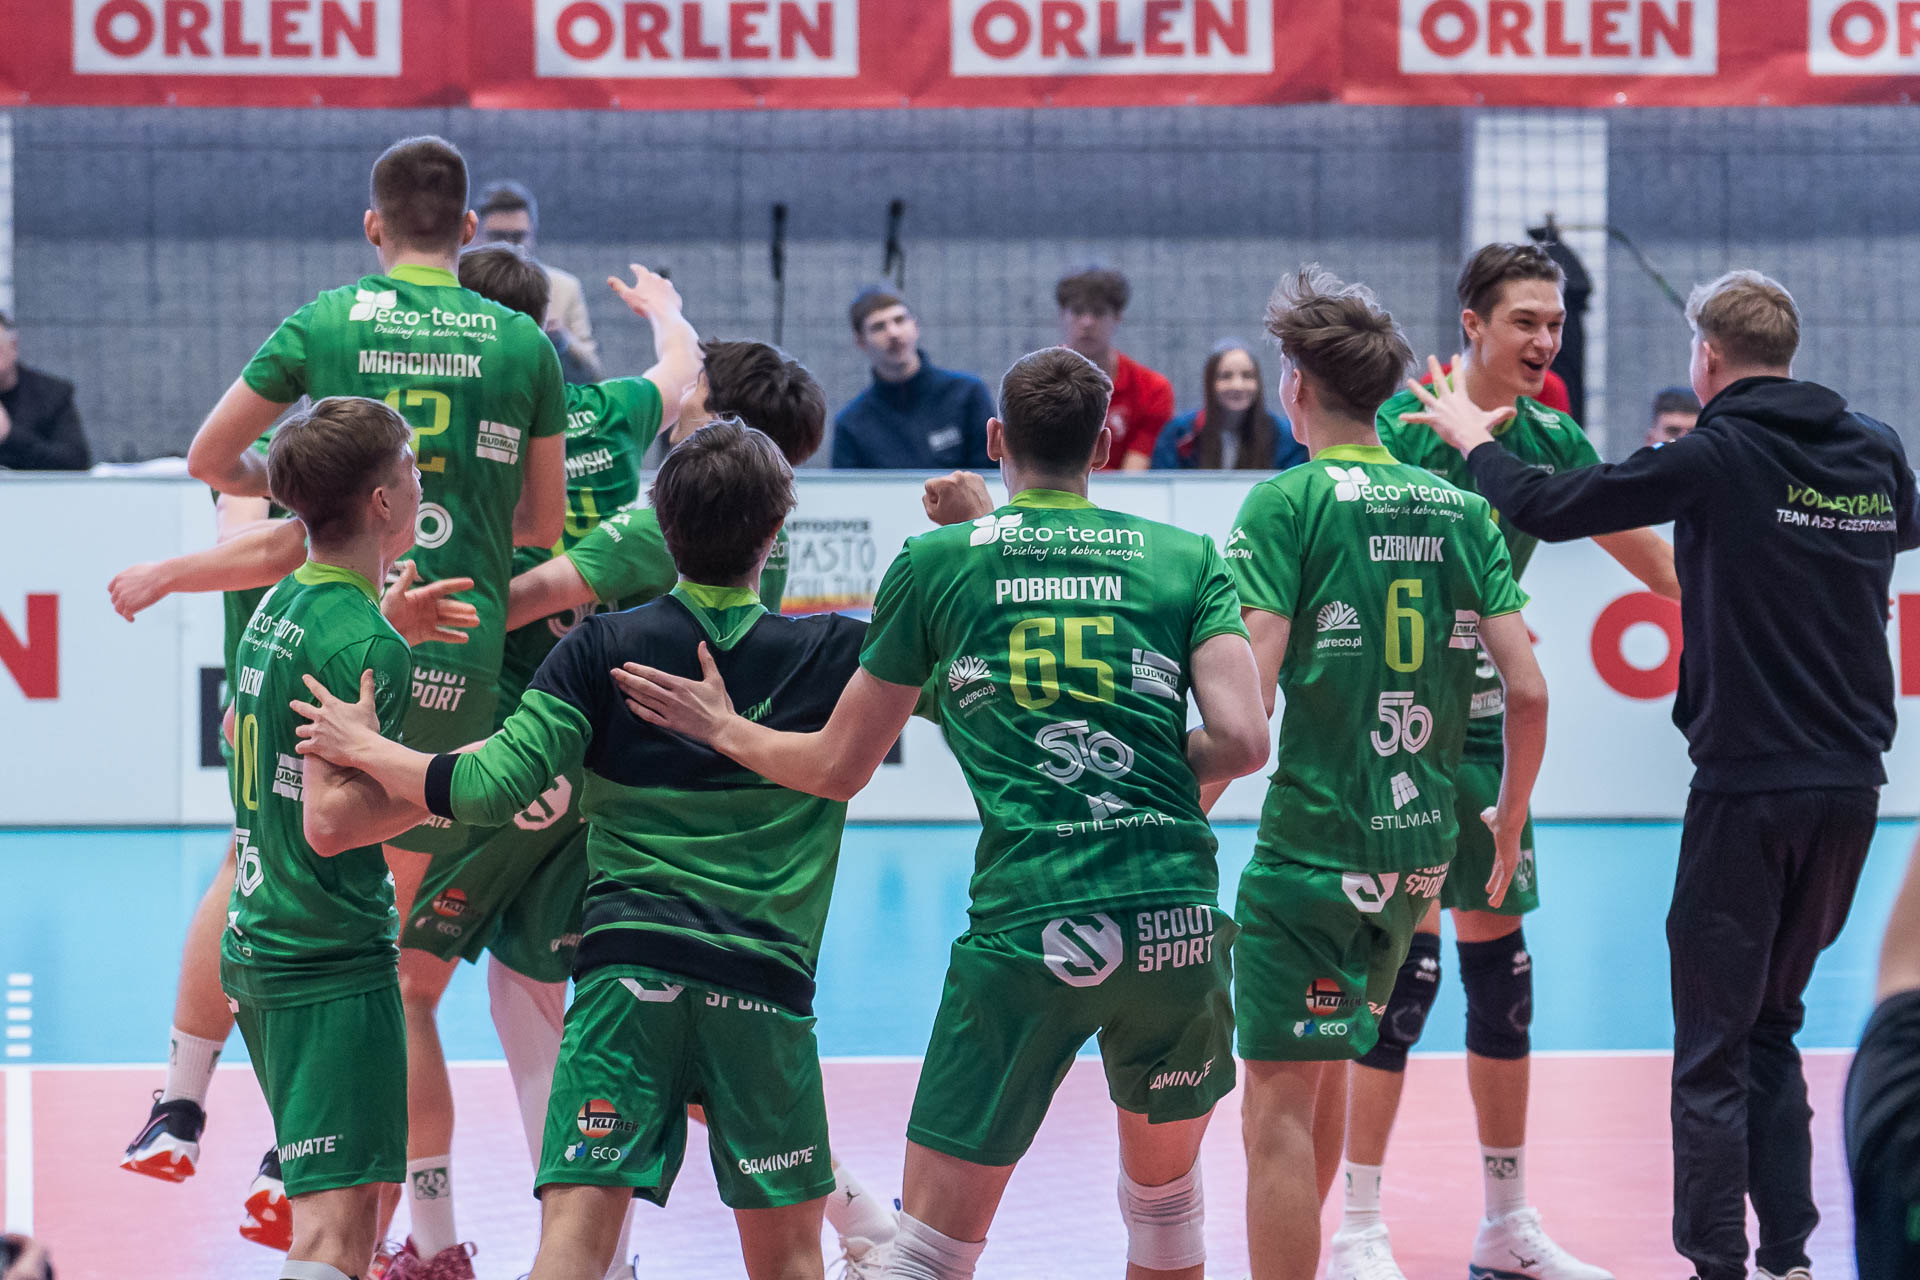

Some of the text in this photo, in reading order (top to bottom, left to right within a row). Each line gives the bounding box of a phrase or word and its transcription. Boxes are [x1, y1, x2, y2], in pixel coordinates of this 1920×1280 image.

[94, 0, 377, 58] ORLEN
[555, 0, 836, 61] ORLEN
[971, 0, 1248, 58] ORLEN
[1420, 0, 1693, 58] ORLEN
[375, 306, 497, 331] eco-team
[358, 350, 483, 378] MARCINIAK
[1360, 482, 1465, 507] eco-team
[1776, 508, 1810, 526] TEAM
[1001, 525, 1145, 548] eco-team
[1368, 535, 1444, 562] CZERWIK
[995, 575, 1122, 605] POBROTYN
[1385, 578, 1425, 673] 6
[1008, 615, 1115, 711] 65
[411, 680, 467, 712] PORT
[1056, 812, 1177, 838] STILMAR
[1371, 809, 1442, 830] STILMAR
[1136, 905, 1214, 942] SCOUT
[1138, 933, 1215, 973] SPORT
